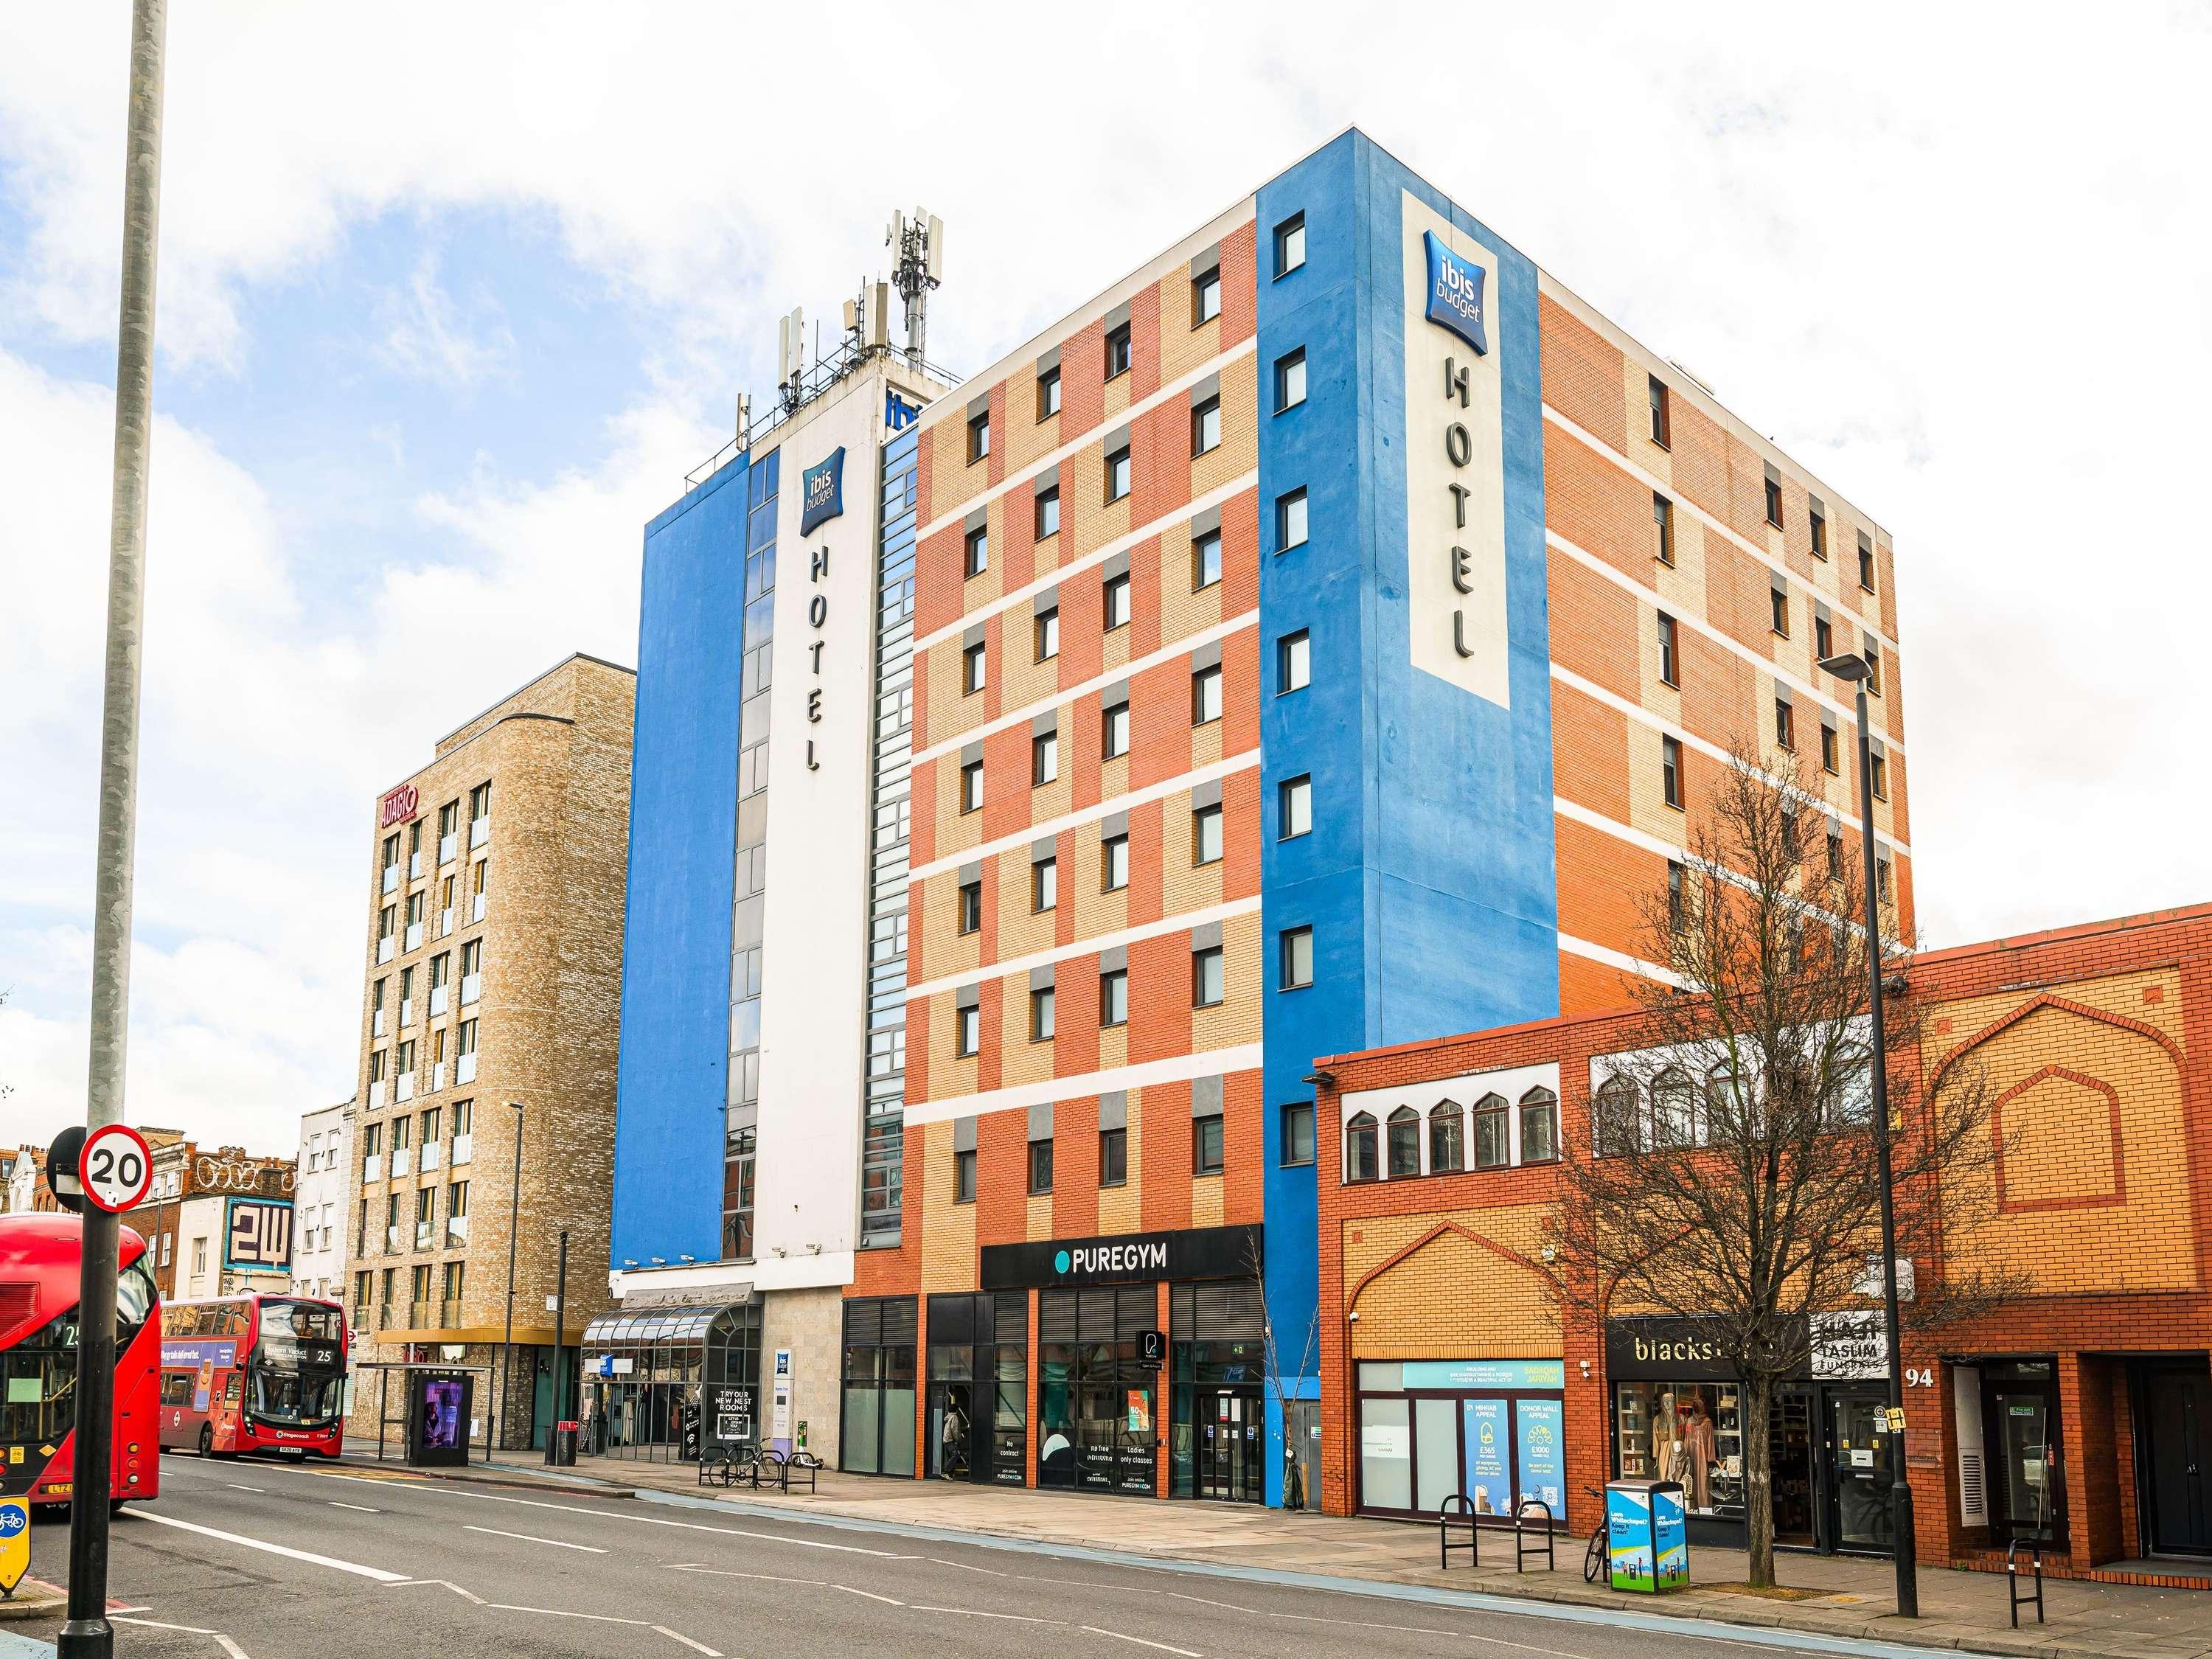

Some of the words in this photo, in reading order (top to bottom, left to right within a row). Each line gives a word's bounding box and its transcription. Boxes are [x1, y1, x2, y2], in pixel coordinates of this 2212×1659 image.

[1441, 254, 1475, 300] ibis
[1436, 277, 1480, 323] budget
[810, 470, 832, 495] ibis
[806, 484, 834, 512] budget
[1444, 356, 1475, 658] HOTEL
[806, 546, 829, 771] HOTEL
[381, 786, 419, 829] ADAGIO
[91, 1148, 142, 1187] 20
[1073, 1242, 1166, 1273] PUREGYM
[317, 1351, 331, 1362] 25
[1822, 1344, 1877, 1357] TASLIM
[1905, 1368, 1933, 1388] 94
[1121, 1456, 1131, 1464] only
[1611, 1517, 1647, 1525] Whitechapel?
